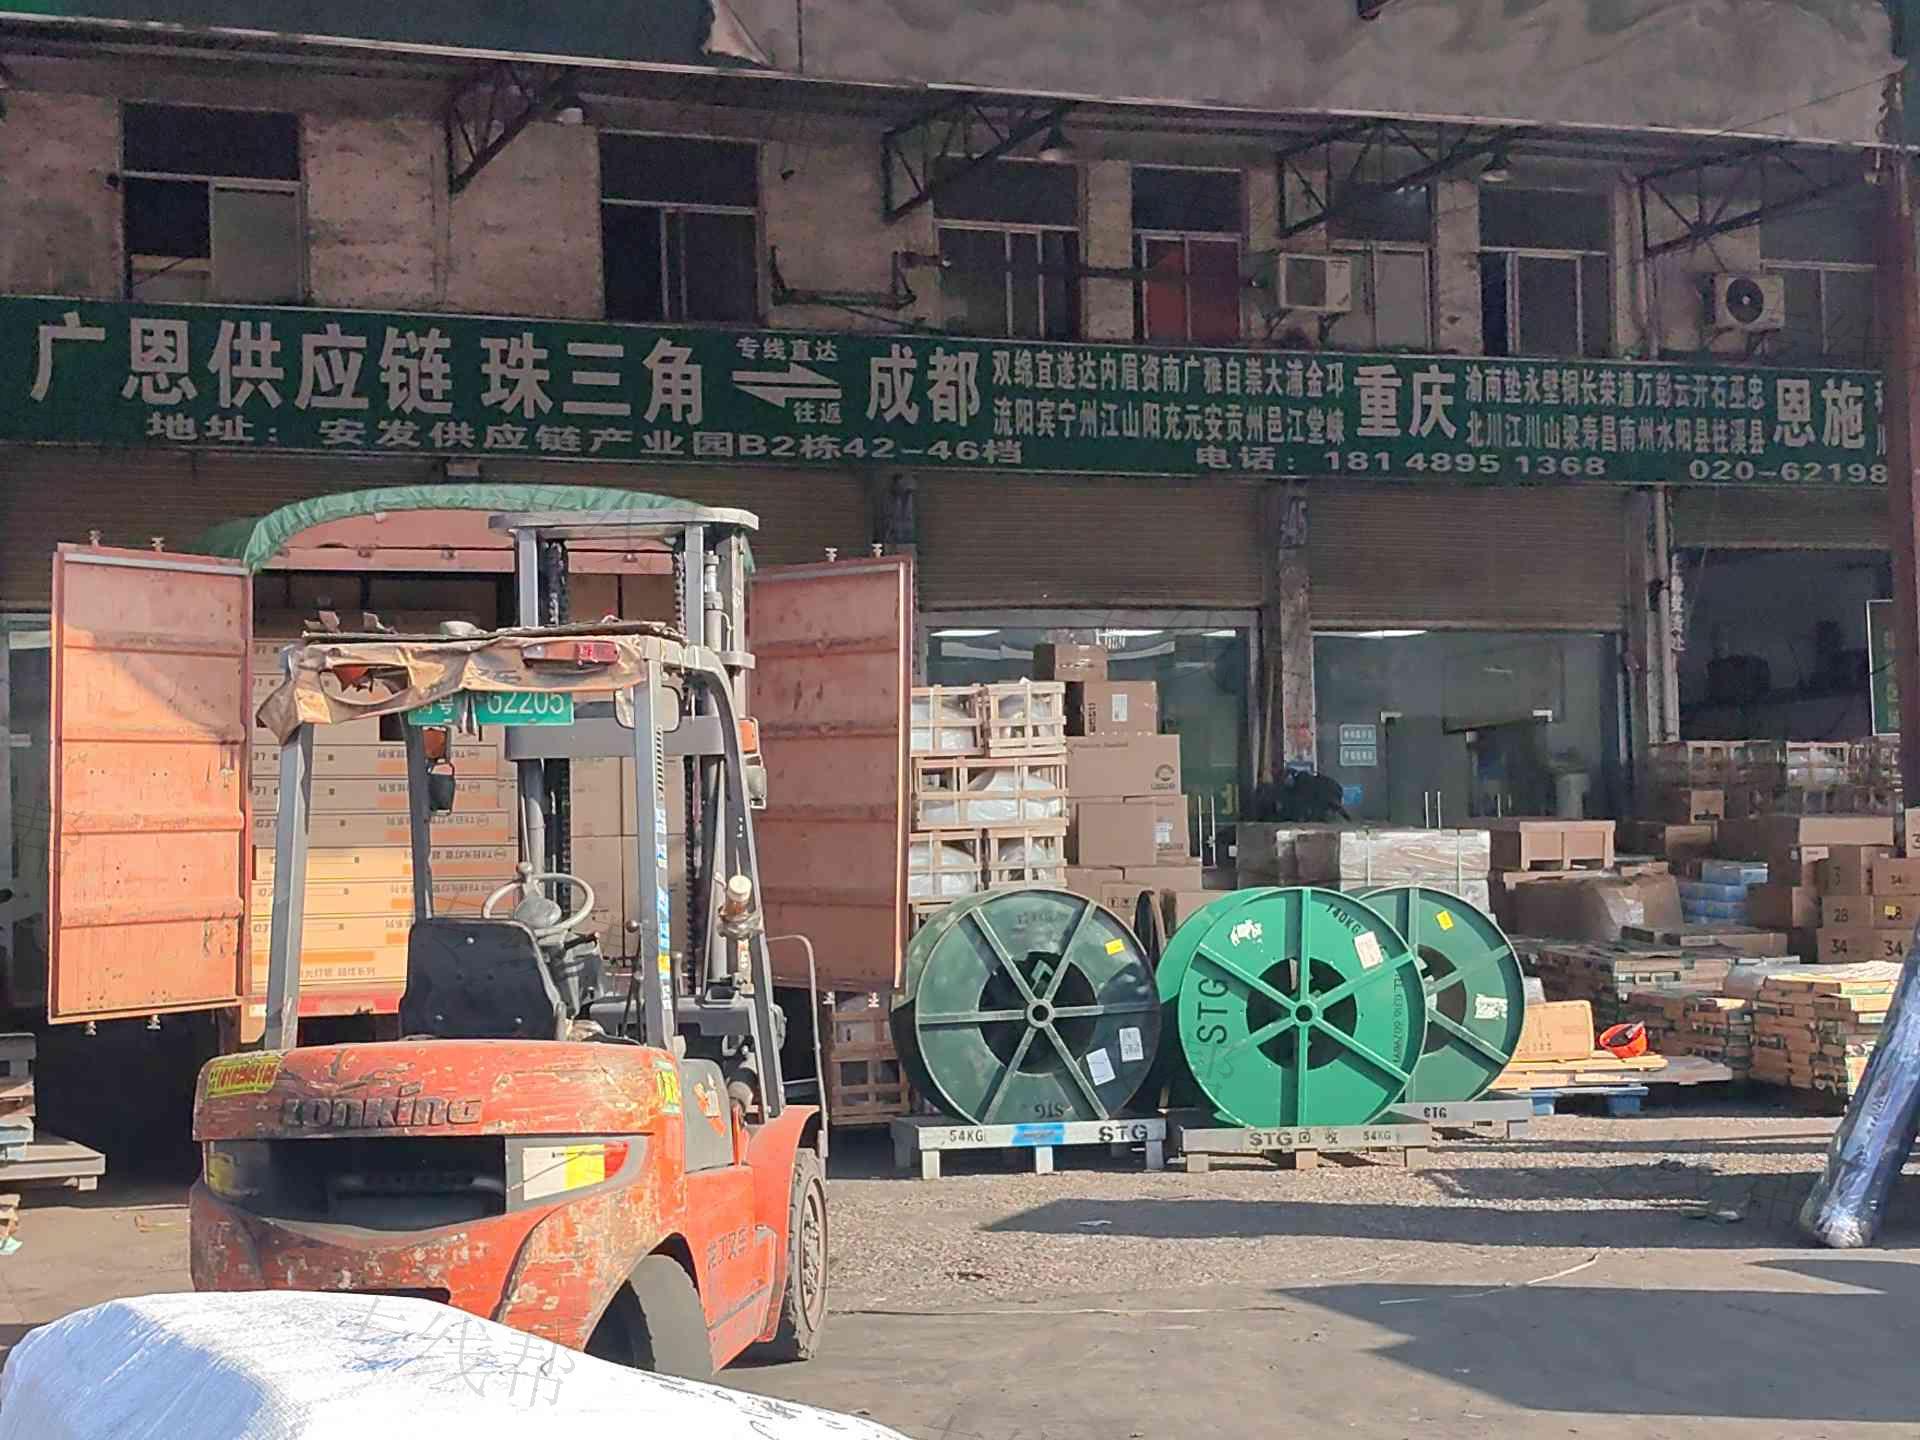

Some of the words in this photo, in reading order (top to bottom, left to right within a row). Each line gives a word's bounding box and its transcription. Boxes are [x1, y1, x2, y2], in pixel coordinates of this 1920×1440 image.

[736, 337, 838, 361] 专线直达
[30, 311, 453, 415] 广恩供应链
[480, 332, 704, 424] 珠三角
[866, 343, 980, 426] 成都
[794, 401, 842, 424] 往返
[1354, 364, 1457, 439] 重庆
[1773, 377, 1865, 449] 恩施
[1689, 459, 1888, 483] 020-62198
[1196, 977, 1229, 1045] STG
[949, 1129, 983, 1143] 54KG
[1098, 1124, 1148, 1144] STG
[1249, 1131, 1293, 1147] STG
